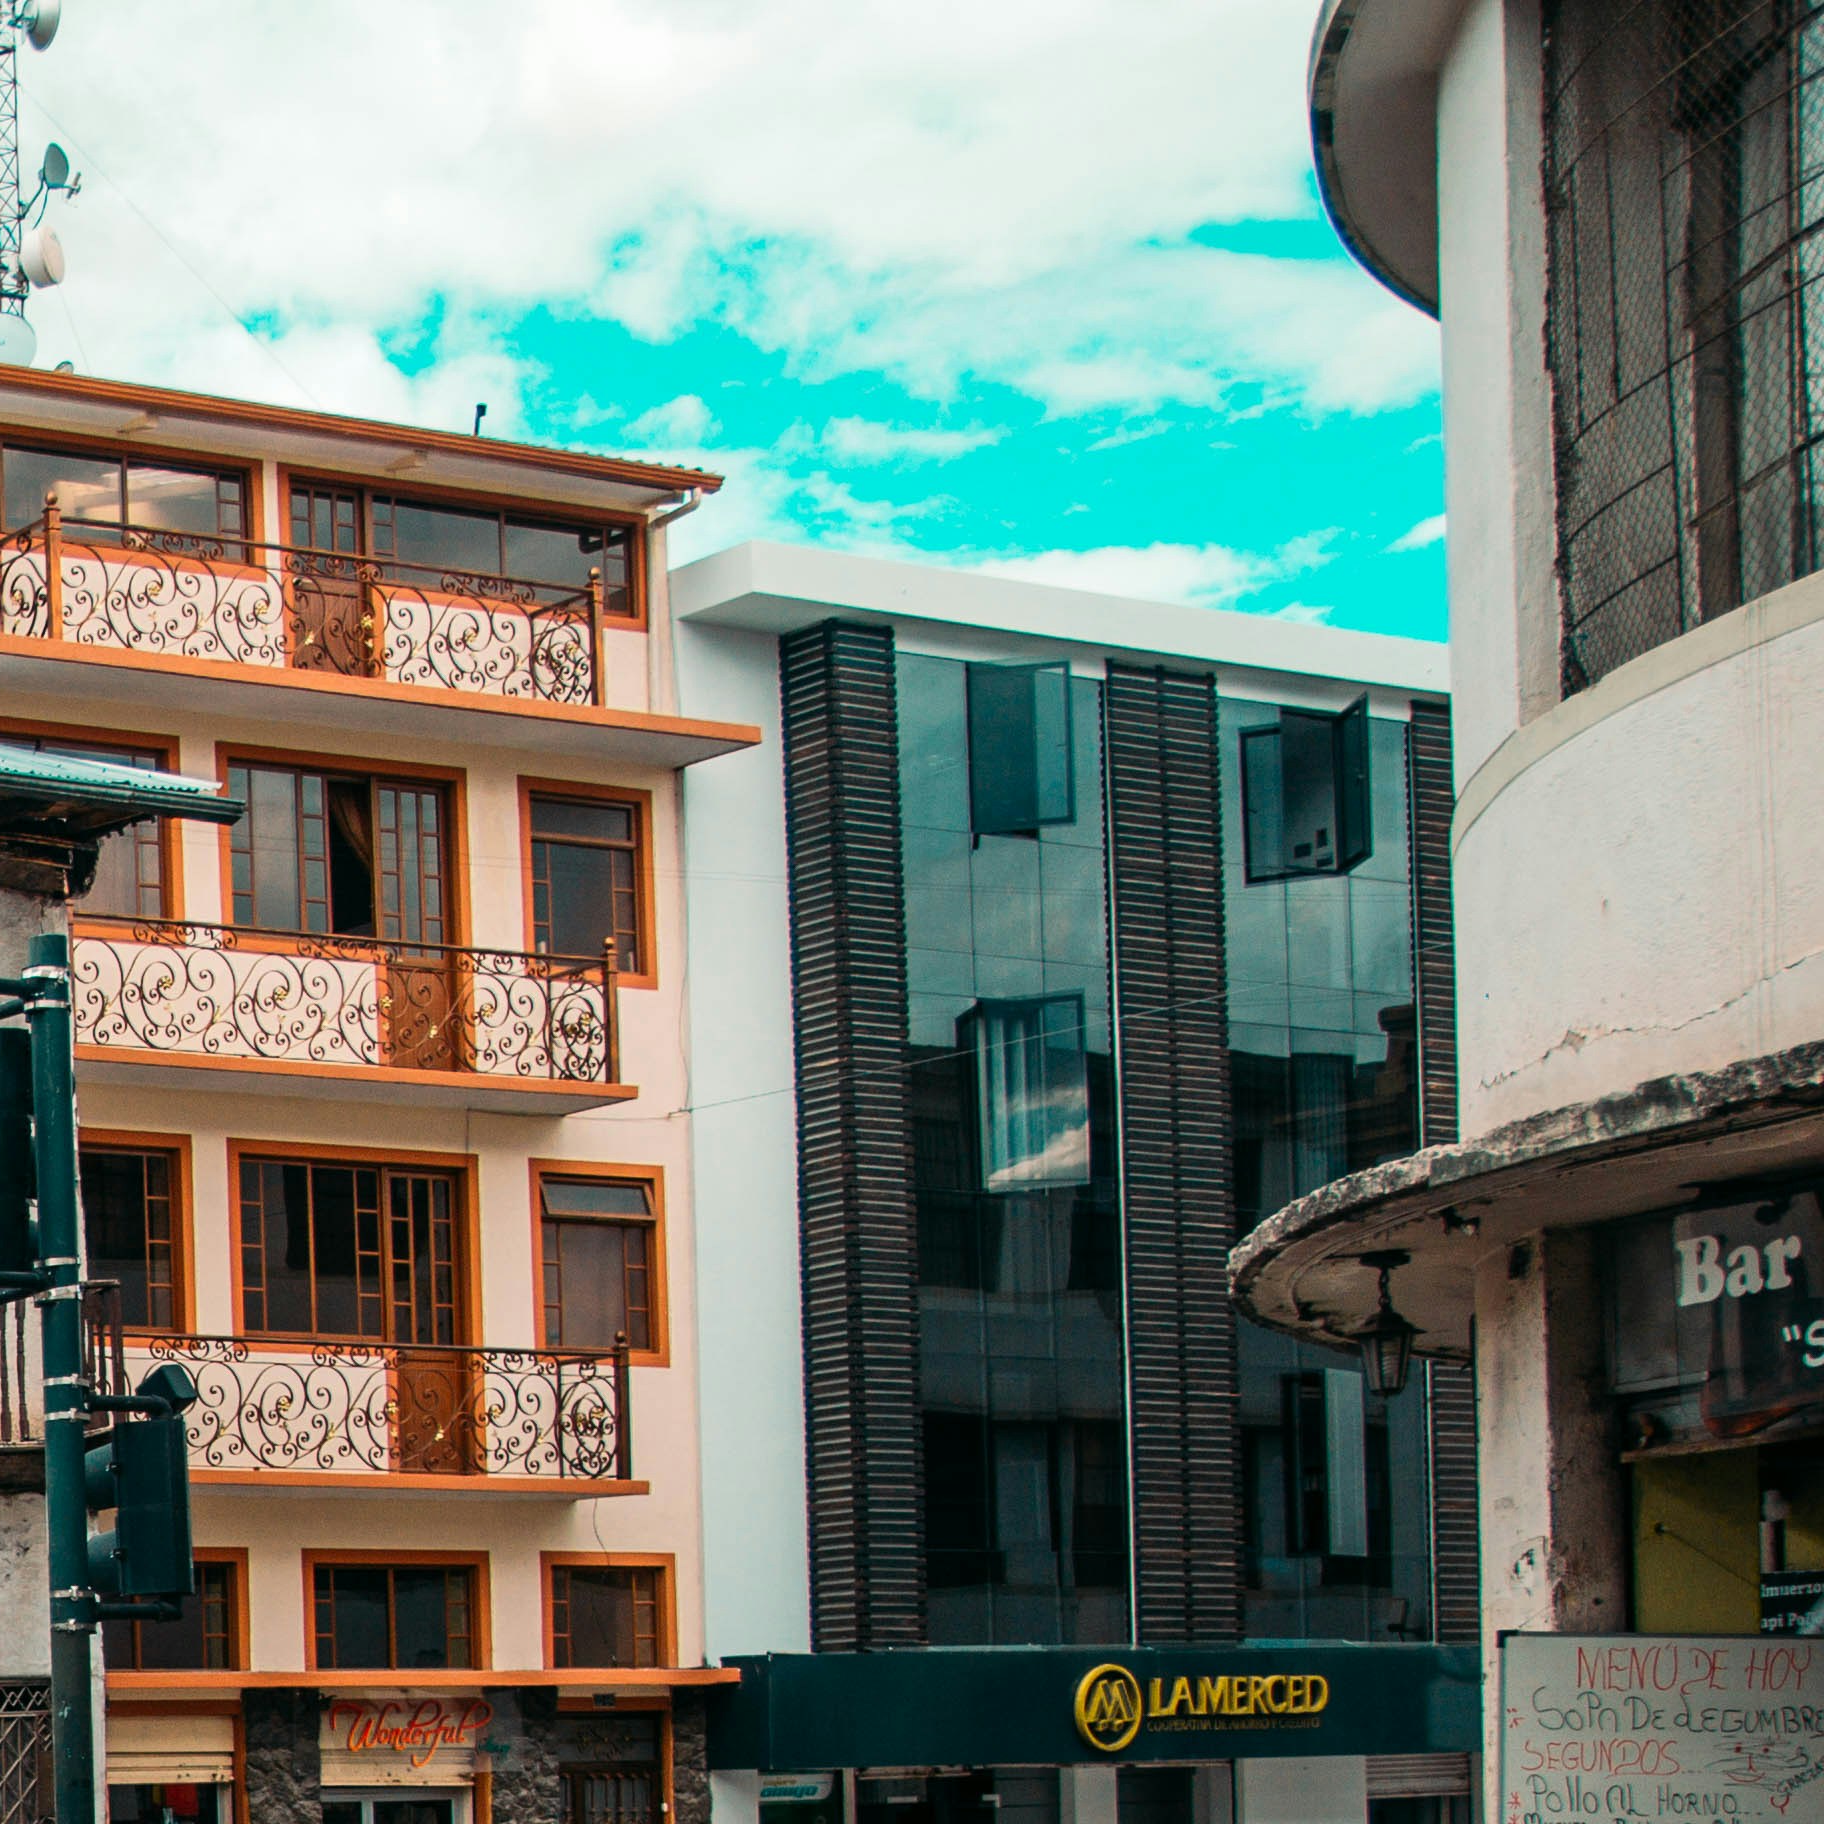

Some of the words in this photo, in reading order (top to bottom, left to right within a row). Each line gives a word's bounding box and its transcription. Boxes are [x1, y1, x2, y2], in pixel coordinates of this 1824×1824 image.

[1675, 1235, 1802, 1307] Bar
[1745, 1645, 1812, 1692] HOY
[330, 1700, 493, 1769] Wonderful
